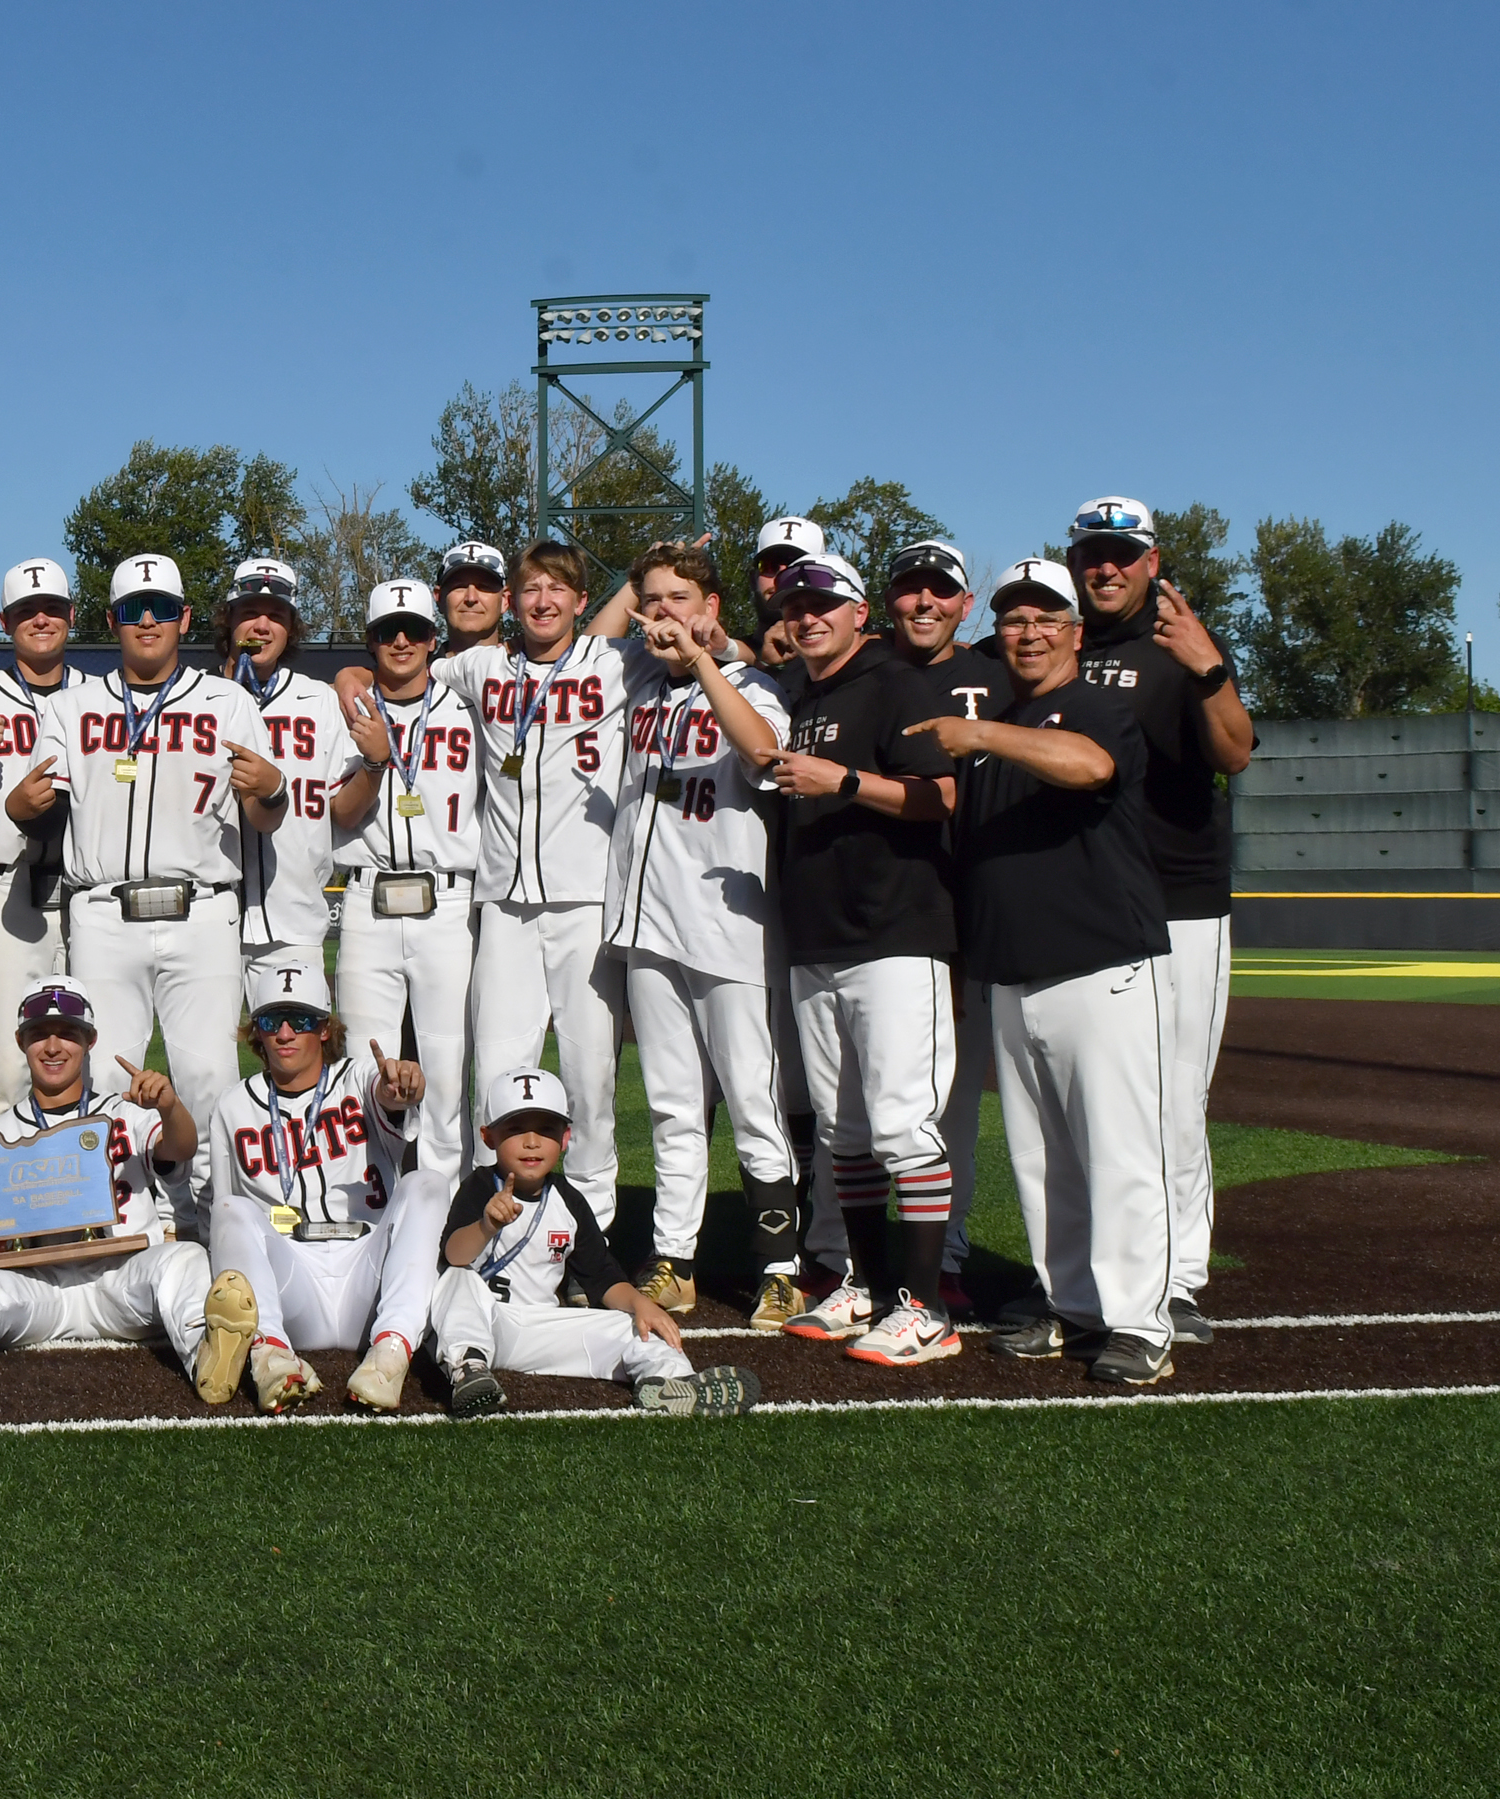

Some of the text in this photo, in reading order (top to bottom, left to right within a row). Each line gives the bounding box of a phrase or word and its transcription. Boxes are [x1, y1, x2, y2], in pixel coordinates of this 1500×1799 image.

[779, 521, 802, 541] T
[461, 543, 483, 561] T
[23, 566, 46, 588] T
[134, 560, 159, 582] T
[1015, 560, 1042, 581] T
[389, 586, 412, 607] T
[481, 674, 604, 725] COLTS
[950, 686, 989, 721] T
[80, 711, 218, 757] COLTS
[630, 705, 720, 758] COLTS
[575, 731, 601, 773] 5
[192, 771, 218, 815] 7
[290, 777, 327, 820] 15
[682, 776, 716, 823] 16
[446, 793, 460, 833] 1
[276, 968, 303, 993] T
[512, 1074, 541, 1101] T
[233, 1095, 369, 1179] COLTS
[8, 1153, 81, 1188] OSAA
[364, 1163, 388, 1210] 3
[30, 1188, 83, 1203] BASEBALL
